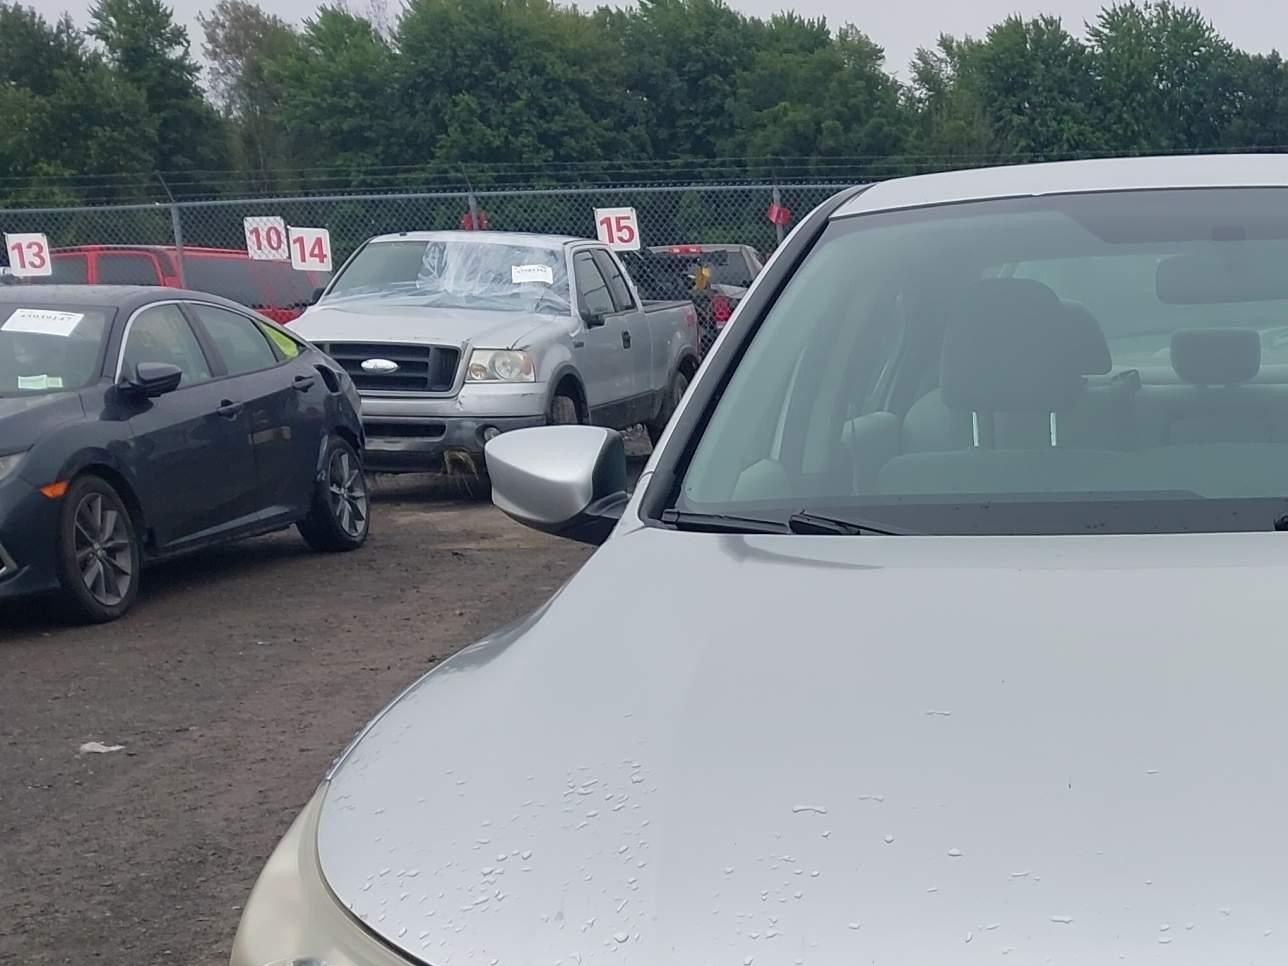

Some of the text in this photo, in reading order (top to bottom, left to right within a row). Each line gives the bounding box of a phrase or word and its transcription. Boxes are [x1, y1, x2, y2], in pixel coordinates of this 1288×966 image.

[249, 226, 282, 251] 10
[600, 216, 635, 243] 15
[11, 241, 46, 269] 13
[293, 236, 327, 263] 14
